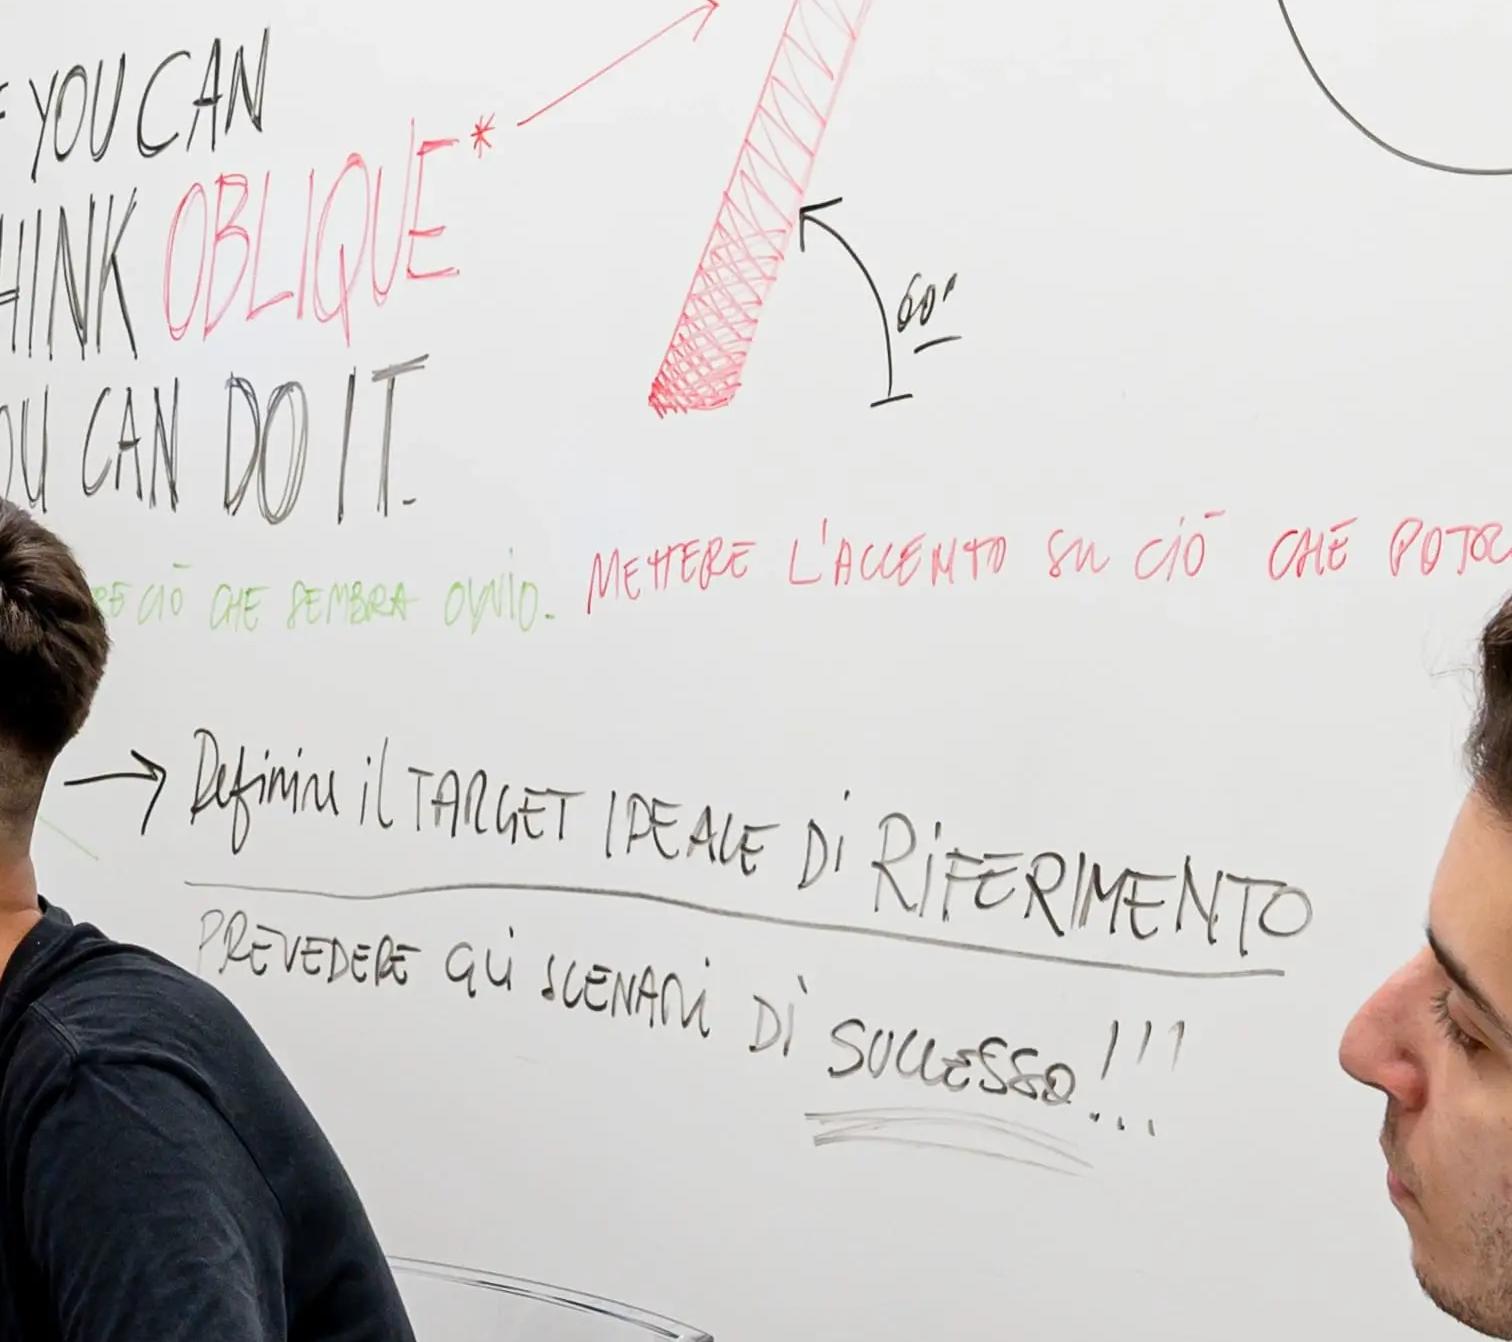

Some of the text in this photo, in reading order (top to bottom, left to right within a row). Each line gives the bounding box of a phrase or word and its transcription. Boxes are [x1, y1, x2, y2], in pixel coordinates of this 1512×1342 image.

[28, 52, 127, 184] YOU
[135, 26, 270, 160] CAN
[162, 117, 460, 348] OBLIQUE
[81, 377, 180, 514] CAN
[223, 370, 309, 526] DO
[208, 582, 270, 632] CHE
[286, 579, 422, 631] SEMBRA
[586, 535, 758, 617] METTERE
[1266, 515, 1359, 582] CHE
[407, 765, 587, 845] TARGET
[605, 789, 781, 878] IDEALE
[197, 908, 423, 987] PREVEDERE
